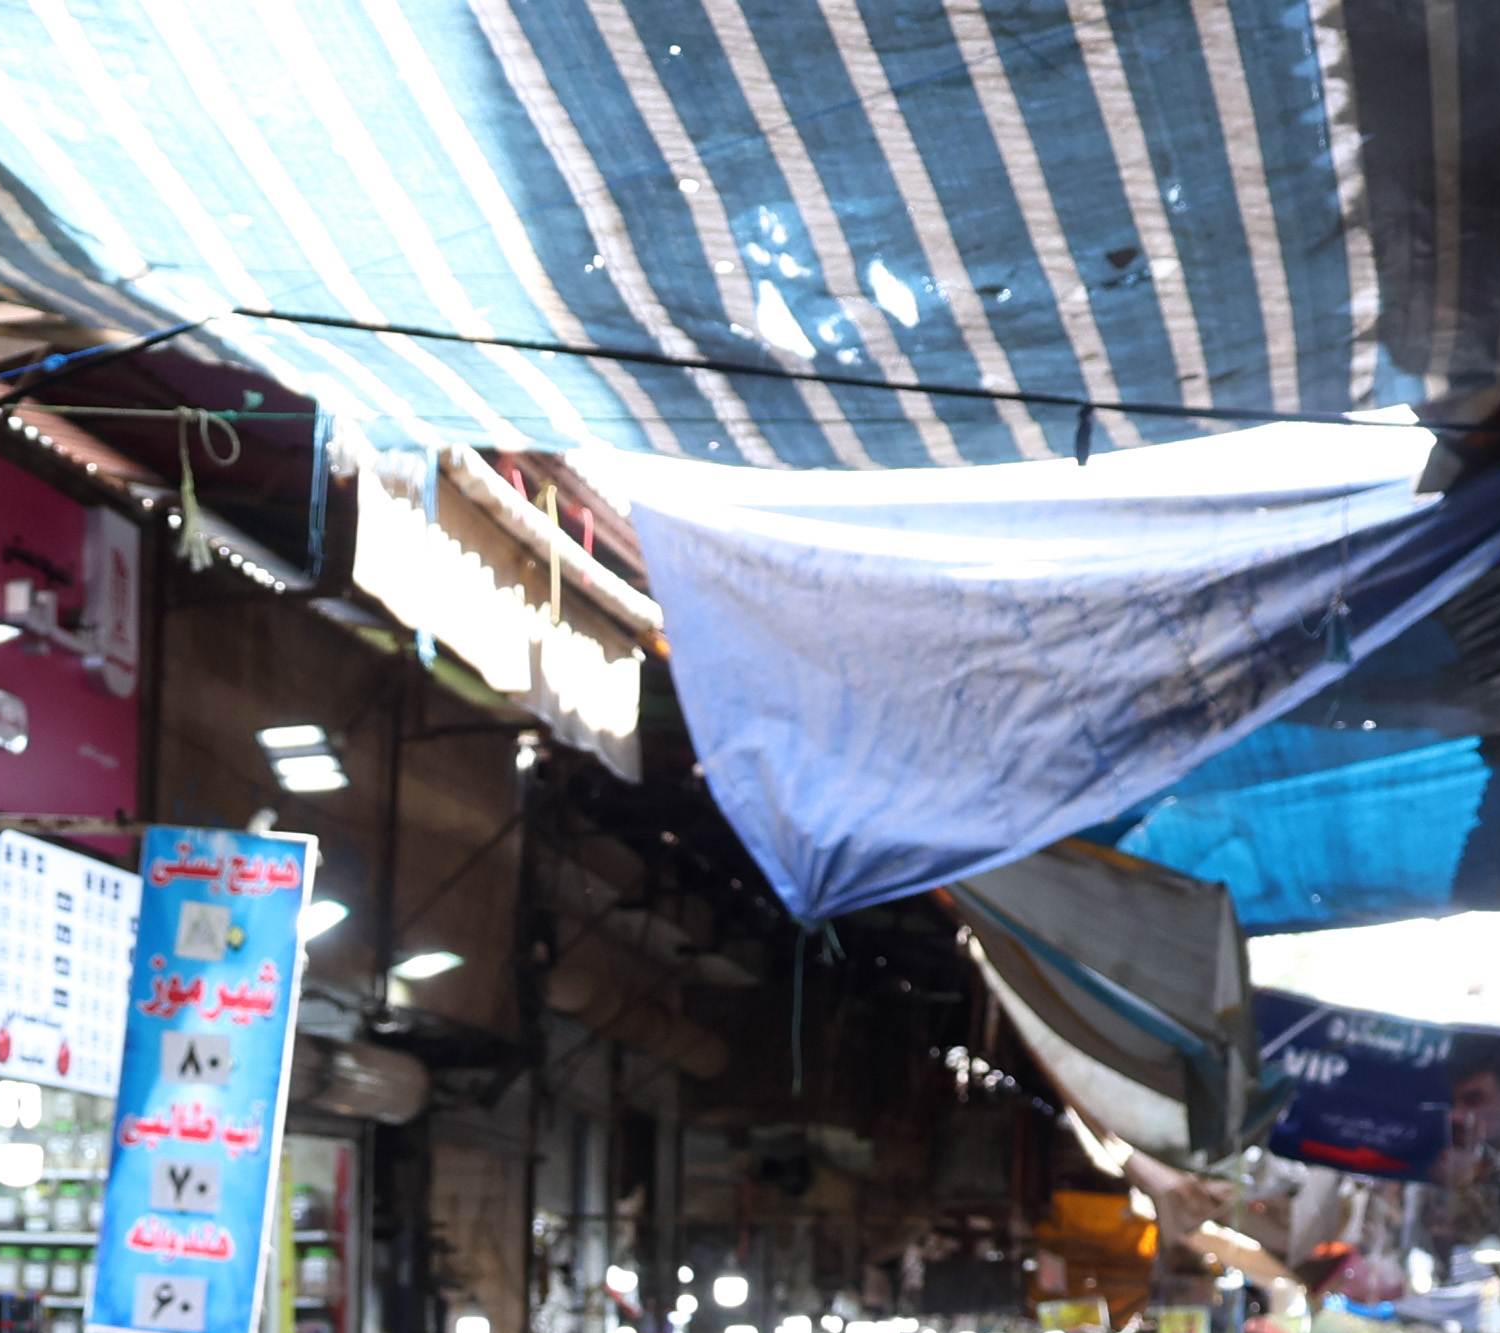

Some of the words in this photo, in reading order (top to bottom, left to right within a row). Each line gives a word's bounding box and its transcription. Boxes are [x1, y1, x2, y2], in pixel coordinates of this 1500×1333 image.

[136, 955, 204, 1020] موز
[198, 960, 279, 1025] شیر
[179, 1041, 221, 1076] ۸۰
[1283, 1046, 1349, 1084] VIP
[118, 1101, 219, 1149] طالبی
[168, 1166, 208, 1199] ۷۰
[126, 1216, 236, 1266] هندوانه
